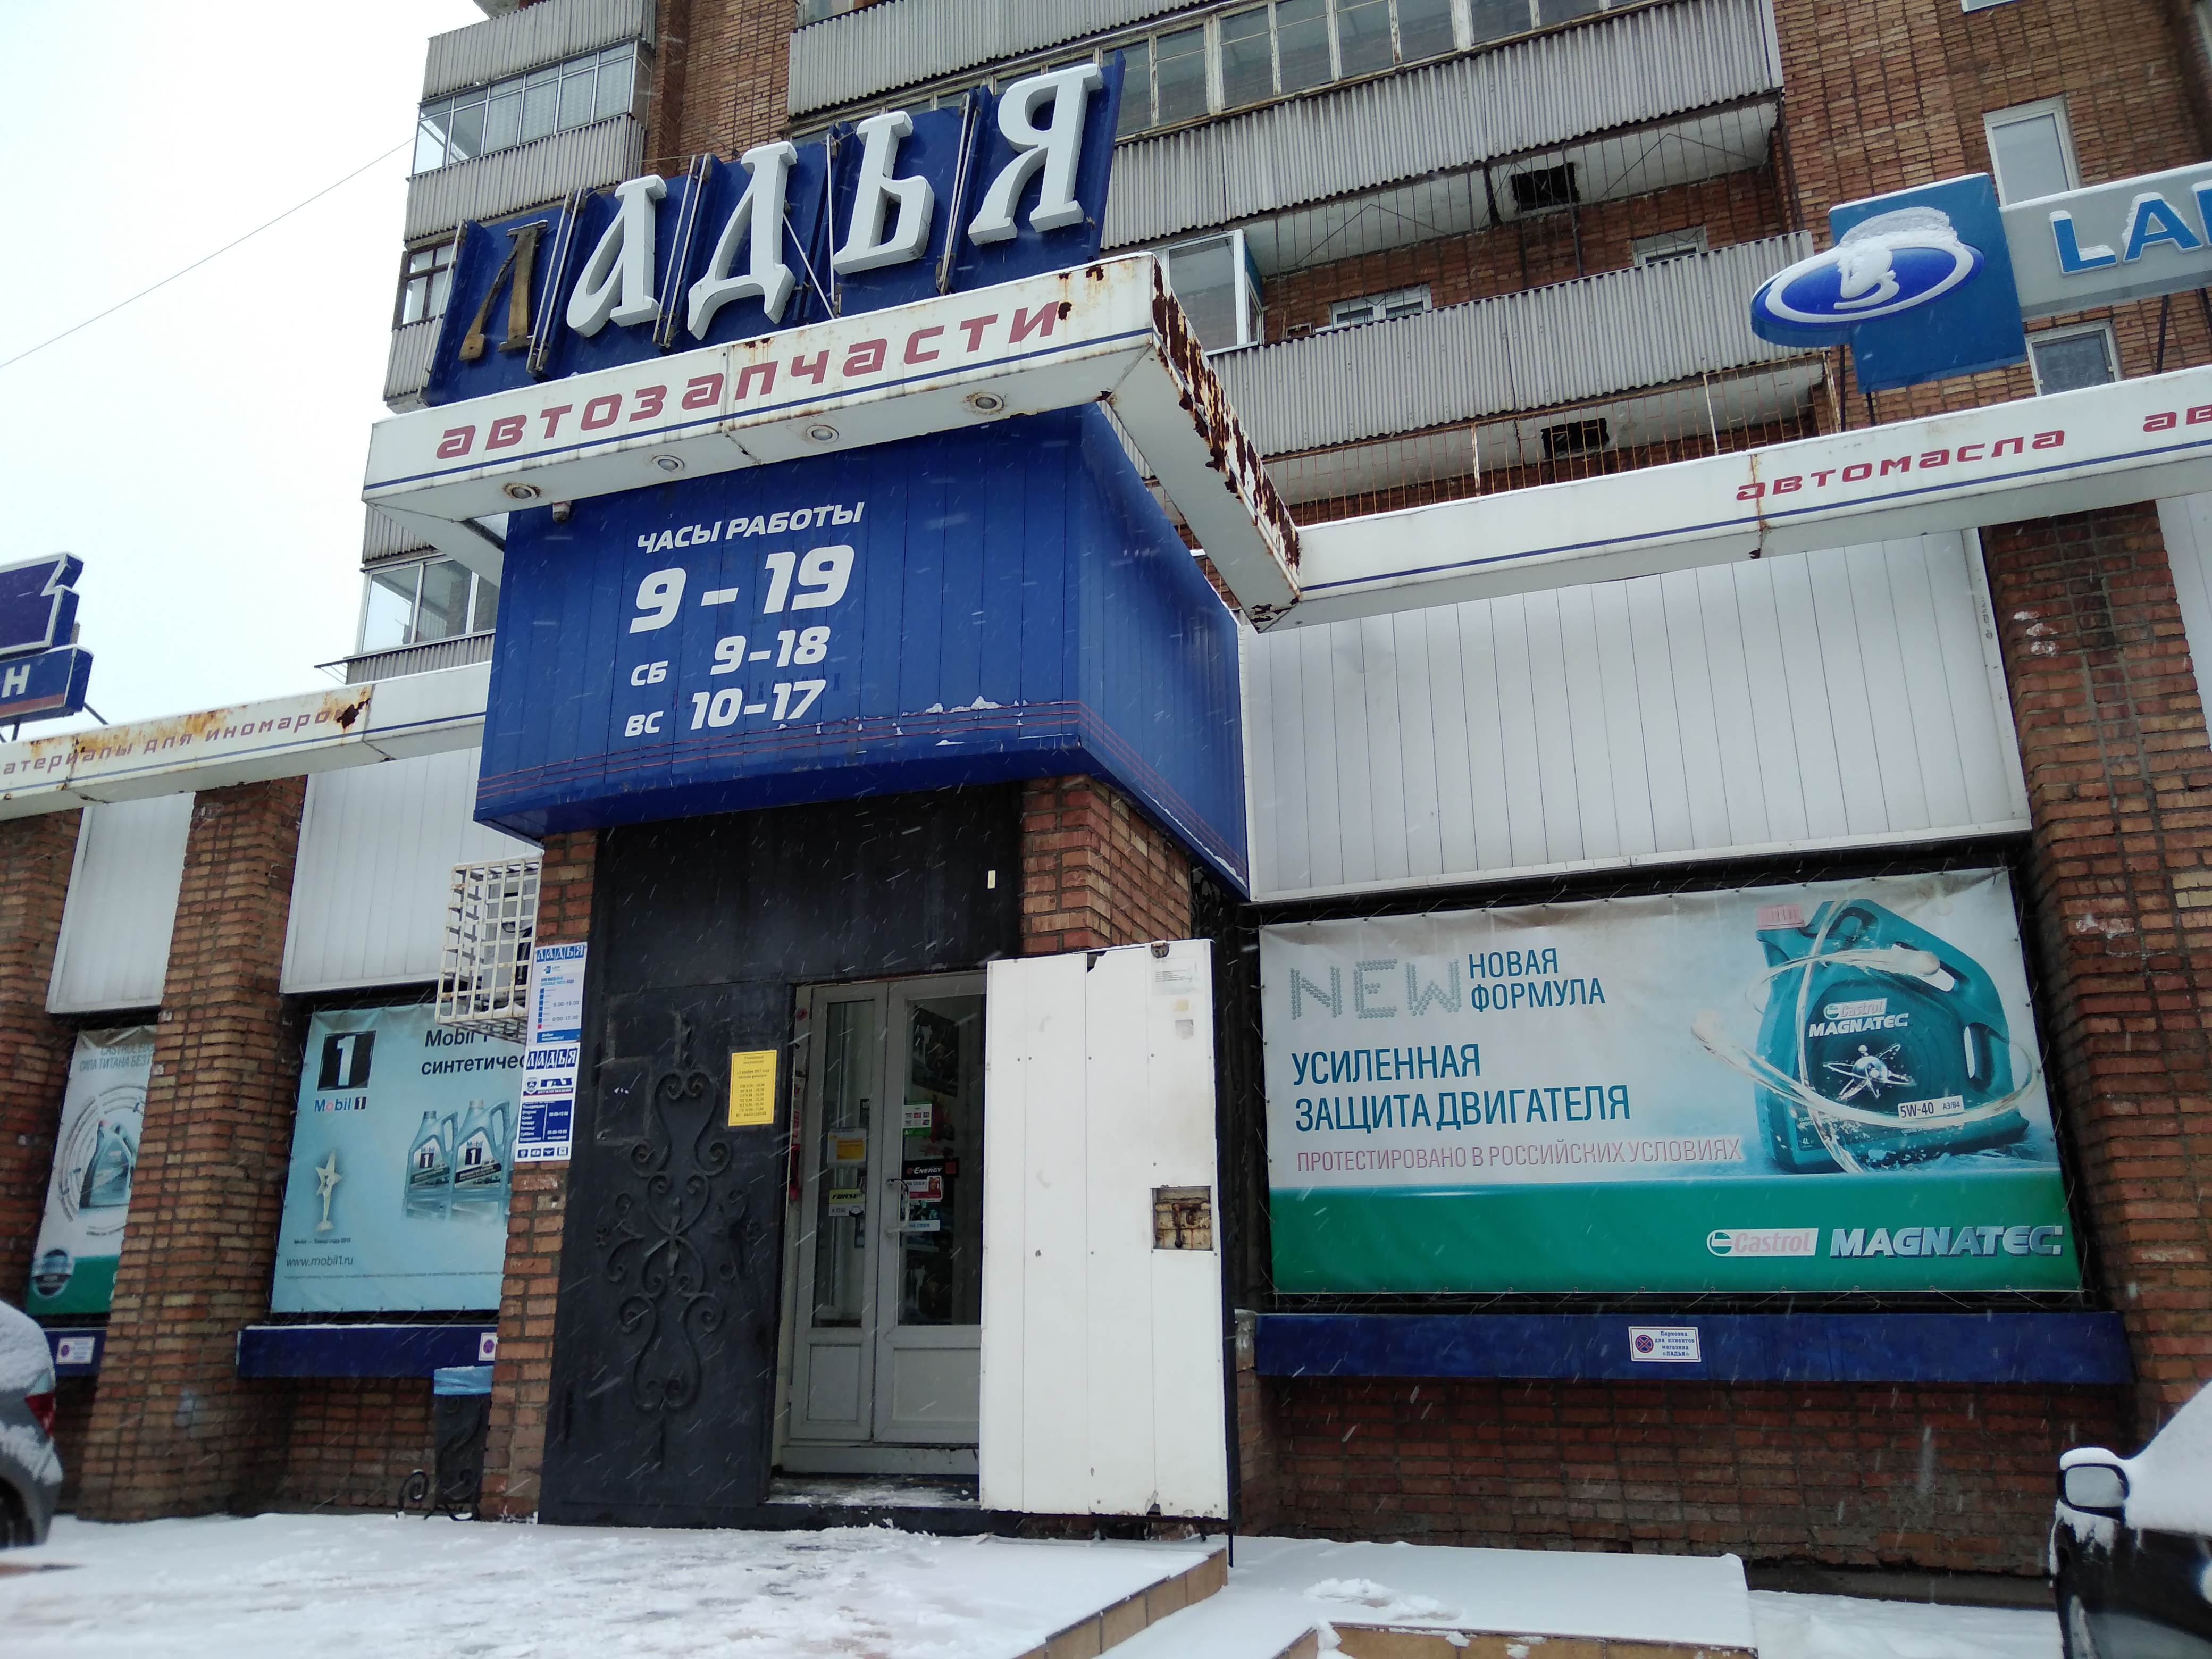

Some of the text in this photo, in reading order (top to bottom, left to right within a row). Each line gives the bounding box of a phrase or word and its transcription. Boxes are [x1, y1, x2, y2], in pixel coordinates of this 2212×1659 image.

[458, 63, 1103, 362] ЛАДЬЯ
[436, 300, 1062, 459] автозапчасти
[1736, 429, 2066, 502] автомасла
[638, 502, 865, 554] ЧАСЫ РАБОТЫ
[631, 660, 668, 686] СБ
[624, 680, 826, 737] ВС 10-17
[143, 734, 192, 755] для
[537, 945, 584, 961] ЛАДЬЯ
[1469, 948, 1559, 980] НОВАЯ
[1290, 959, 1461, 1020] NEW
[1471, 978, 1606, 1013] ФОРМУЛА
[1809, 1013, 1909, 1037] MAGNATEC
[1841, 1001, 1883, 1017] Castrol
[527, 1050, 577, 1068] ЛАДЬЯ
[1292, 1043, 1480, 1085] УСИЛЕННАЯ
[314, 1097, 351, 1112] Mobil
[1295, 1085, 1630, 1134] ЗАЩИТА ДВИГАТЕЛЯ
[1900, 1101, 1960, 1118] 5W-40 A3/B4
[1297, 1138, 1743, 1172] ПРОТЕСТИРОВАНО В РОССИЙСКИХ УСЛОВИЯХ
[1731, 1226, 2064, 1259] Castrol MAGNATEC
[286, 1255, 353, 1267] www.mobil1.ru
